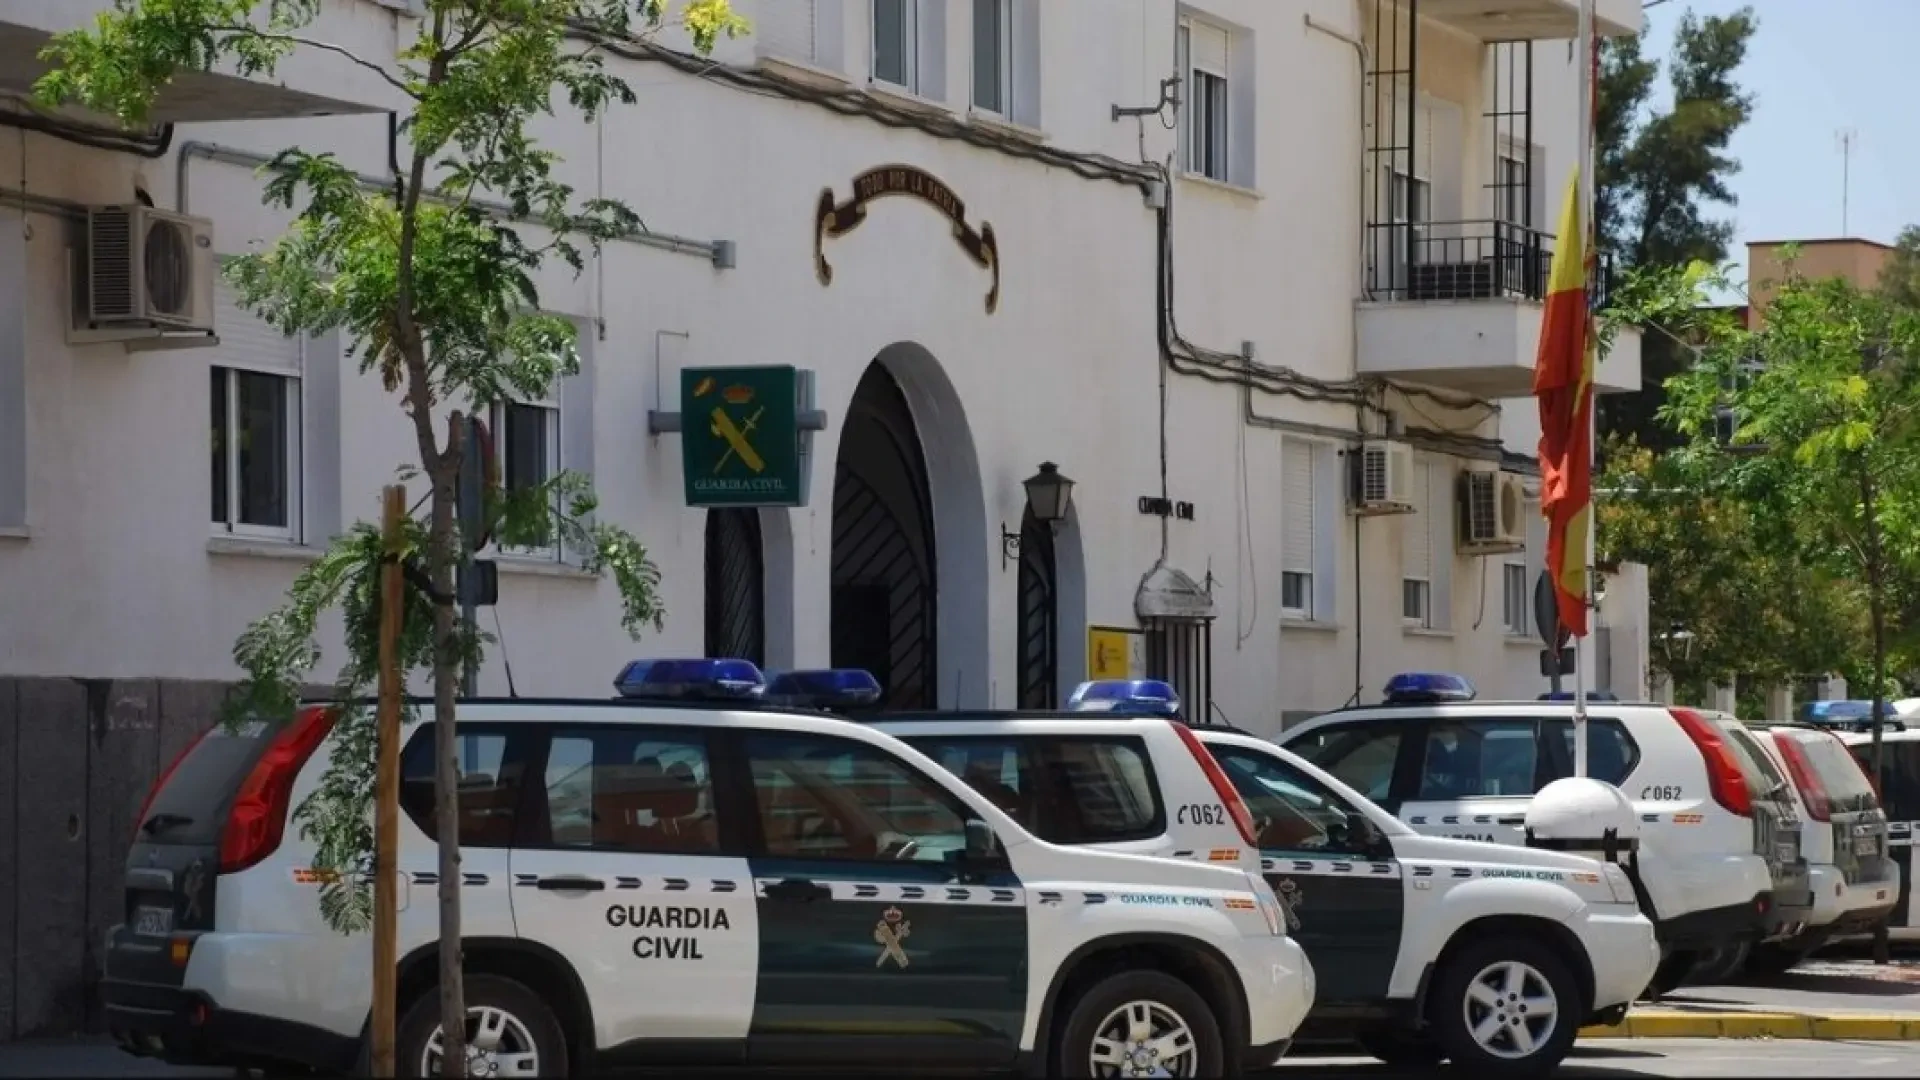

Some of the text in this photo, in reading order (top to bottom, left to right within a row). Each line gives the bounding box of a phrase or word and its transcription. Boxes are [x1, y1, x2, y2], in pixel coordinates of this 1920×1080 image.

[694, 477, 787, 490] GUARDIA CIVIL
[1653, 785, 1682, 801] 062
[1190, 803, 1225, 825] 062
[1481, 868, 1564, 881] GUARDIA CIVIL
[1121, 893, 1213, 907] GUARDIA CIVIL
[606, 904, 730, 930] GUARDIA
[632, 935, 704, 960] CIVIL
